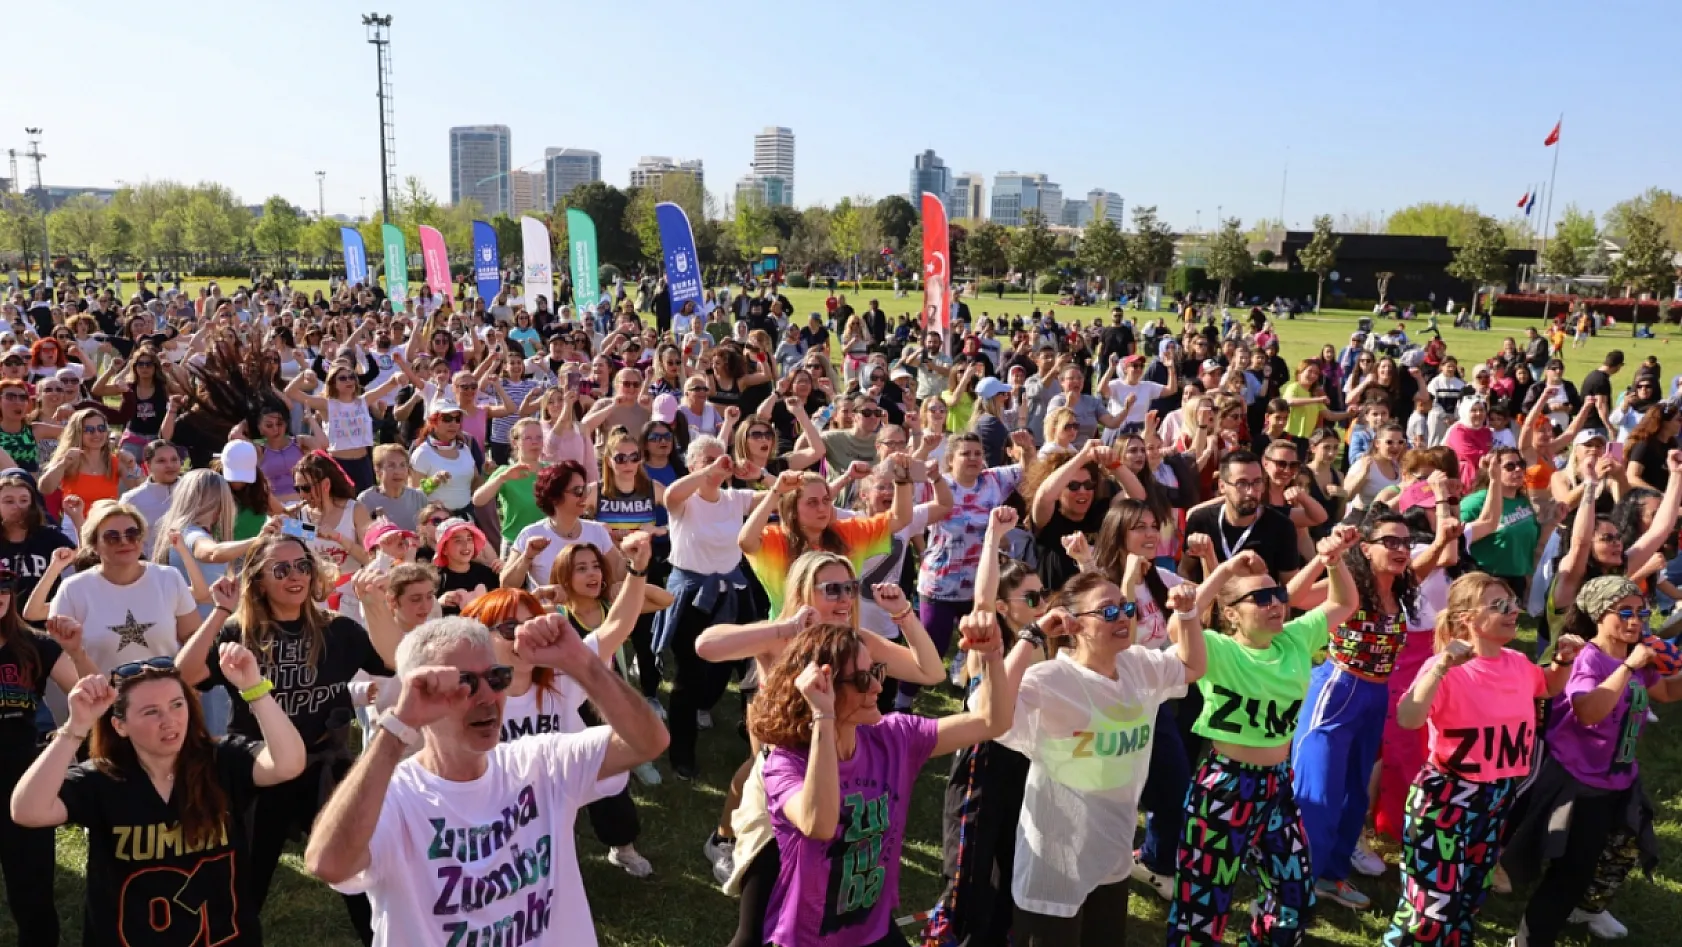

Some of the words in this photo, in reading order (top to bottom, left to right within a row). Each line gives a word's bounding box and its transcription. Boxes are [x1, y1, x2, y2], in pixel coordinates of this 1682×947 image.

[600, 499, 653, 513] ZUMBA
[1072, 724, 1150, 759] ZUMB
[112, 820, 229, 861] ZUMA
[428, 784, 540, 864] Zumba
[433, 834, 551, 915] Zumba
